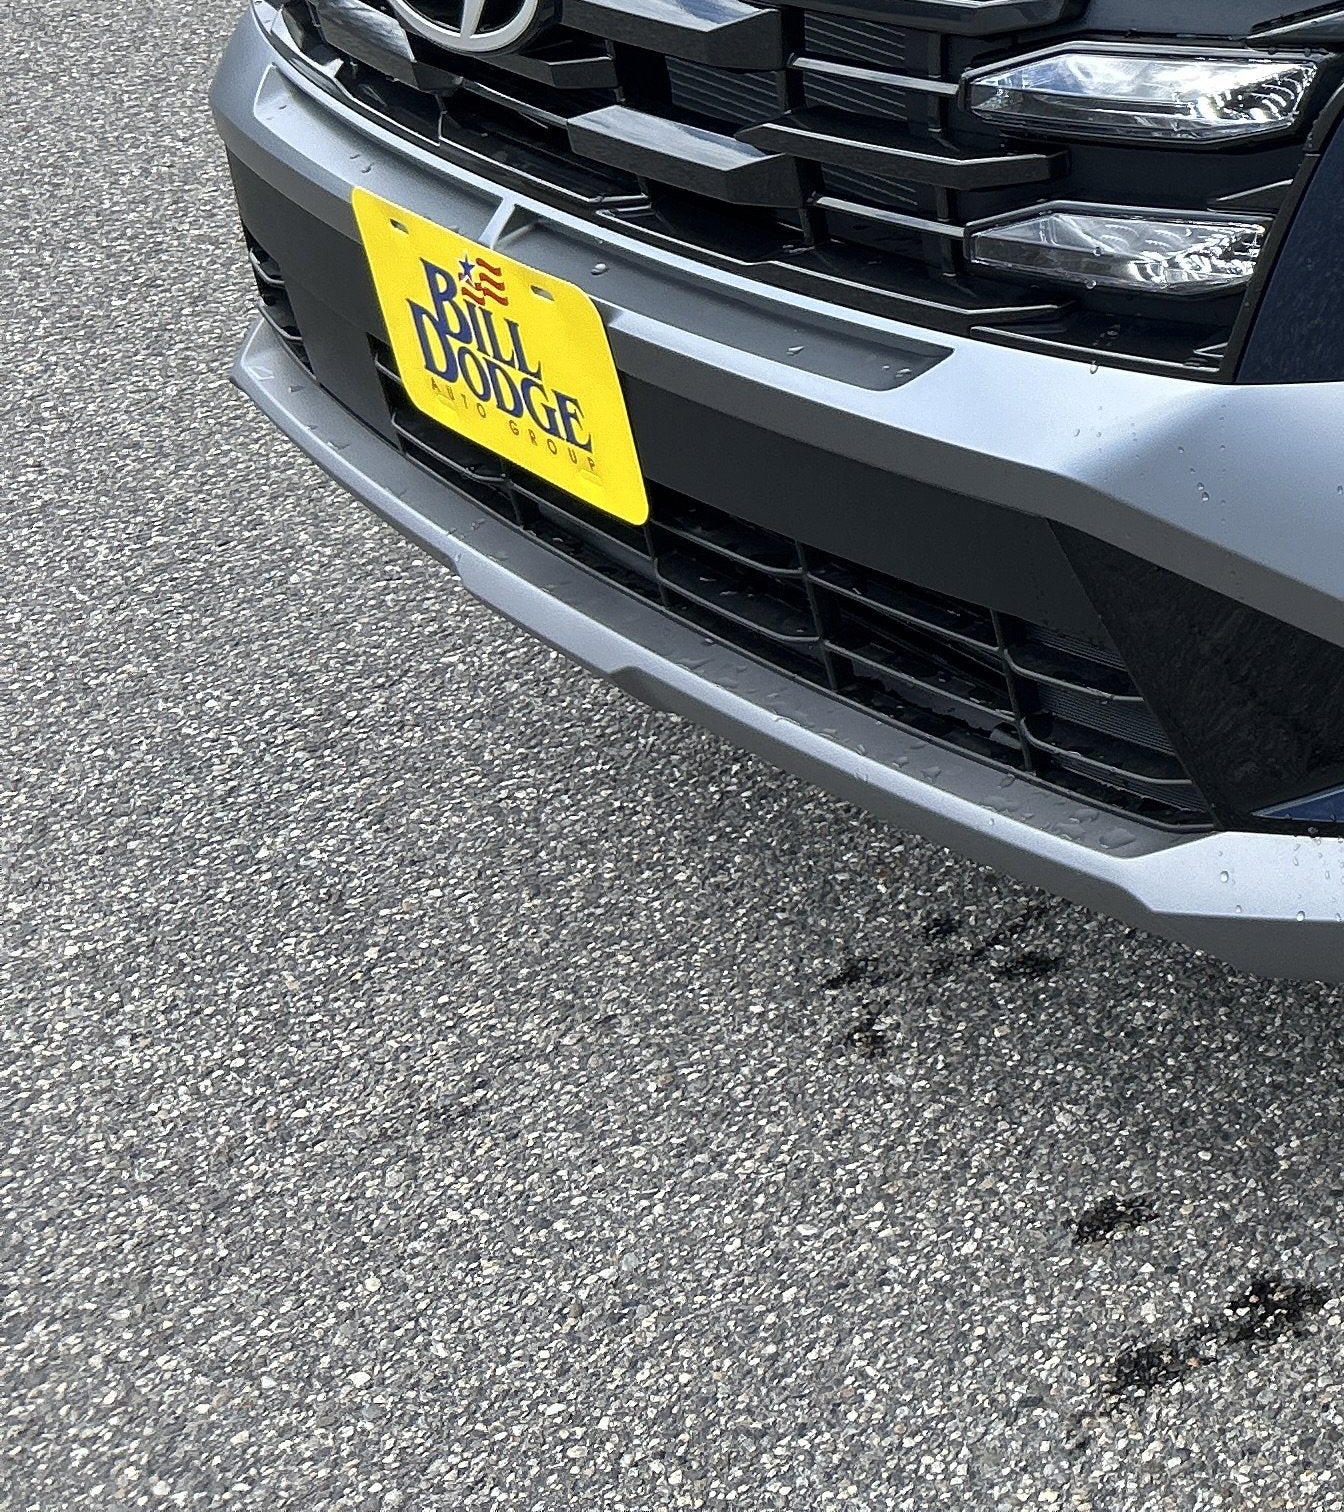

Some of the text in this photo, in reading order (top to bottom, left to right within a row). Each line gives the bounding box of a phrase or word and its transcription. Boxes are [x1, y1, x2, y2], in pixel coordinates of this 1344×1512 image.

[405, 298, 593, 453] DODGE
[418, 257, 543, 381] BILL
[430, 377, 597, 473] AUTO GROUP
